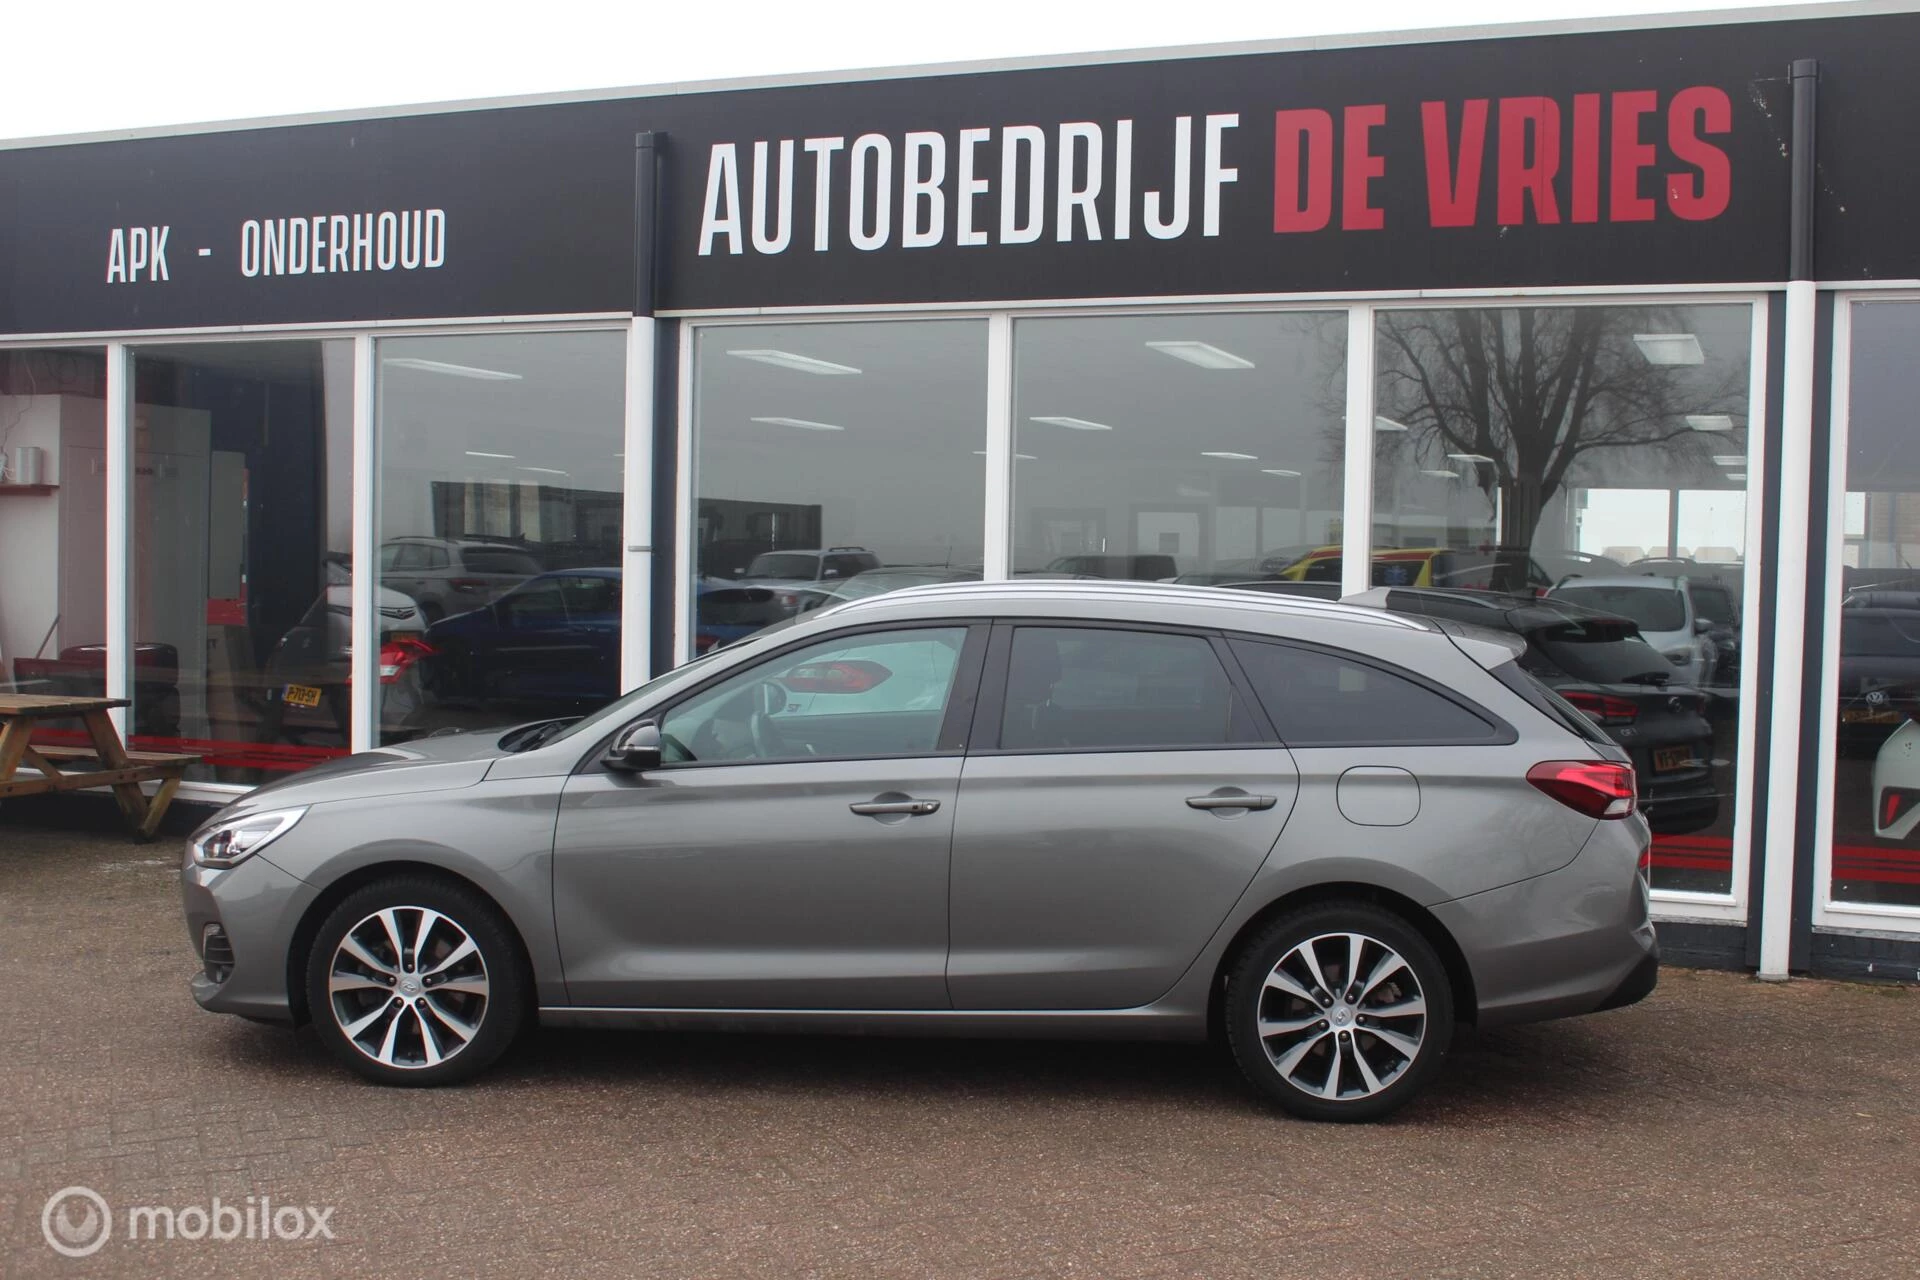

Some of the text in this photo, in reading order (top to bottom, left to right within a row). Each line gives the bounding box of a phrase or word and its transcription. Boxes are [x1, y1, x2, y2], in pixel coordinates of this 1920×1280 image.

[698, 86, 1732, 255] AUTOBEDRIJF DE VRIES
[107, 226, 169, 283] APK
[241, 208, 446, 278] ONDERHOUD
